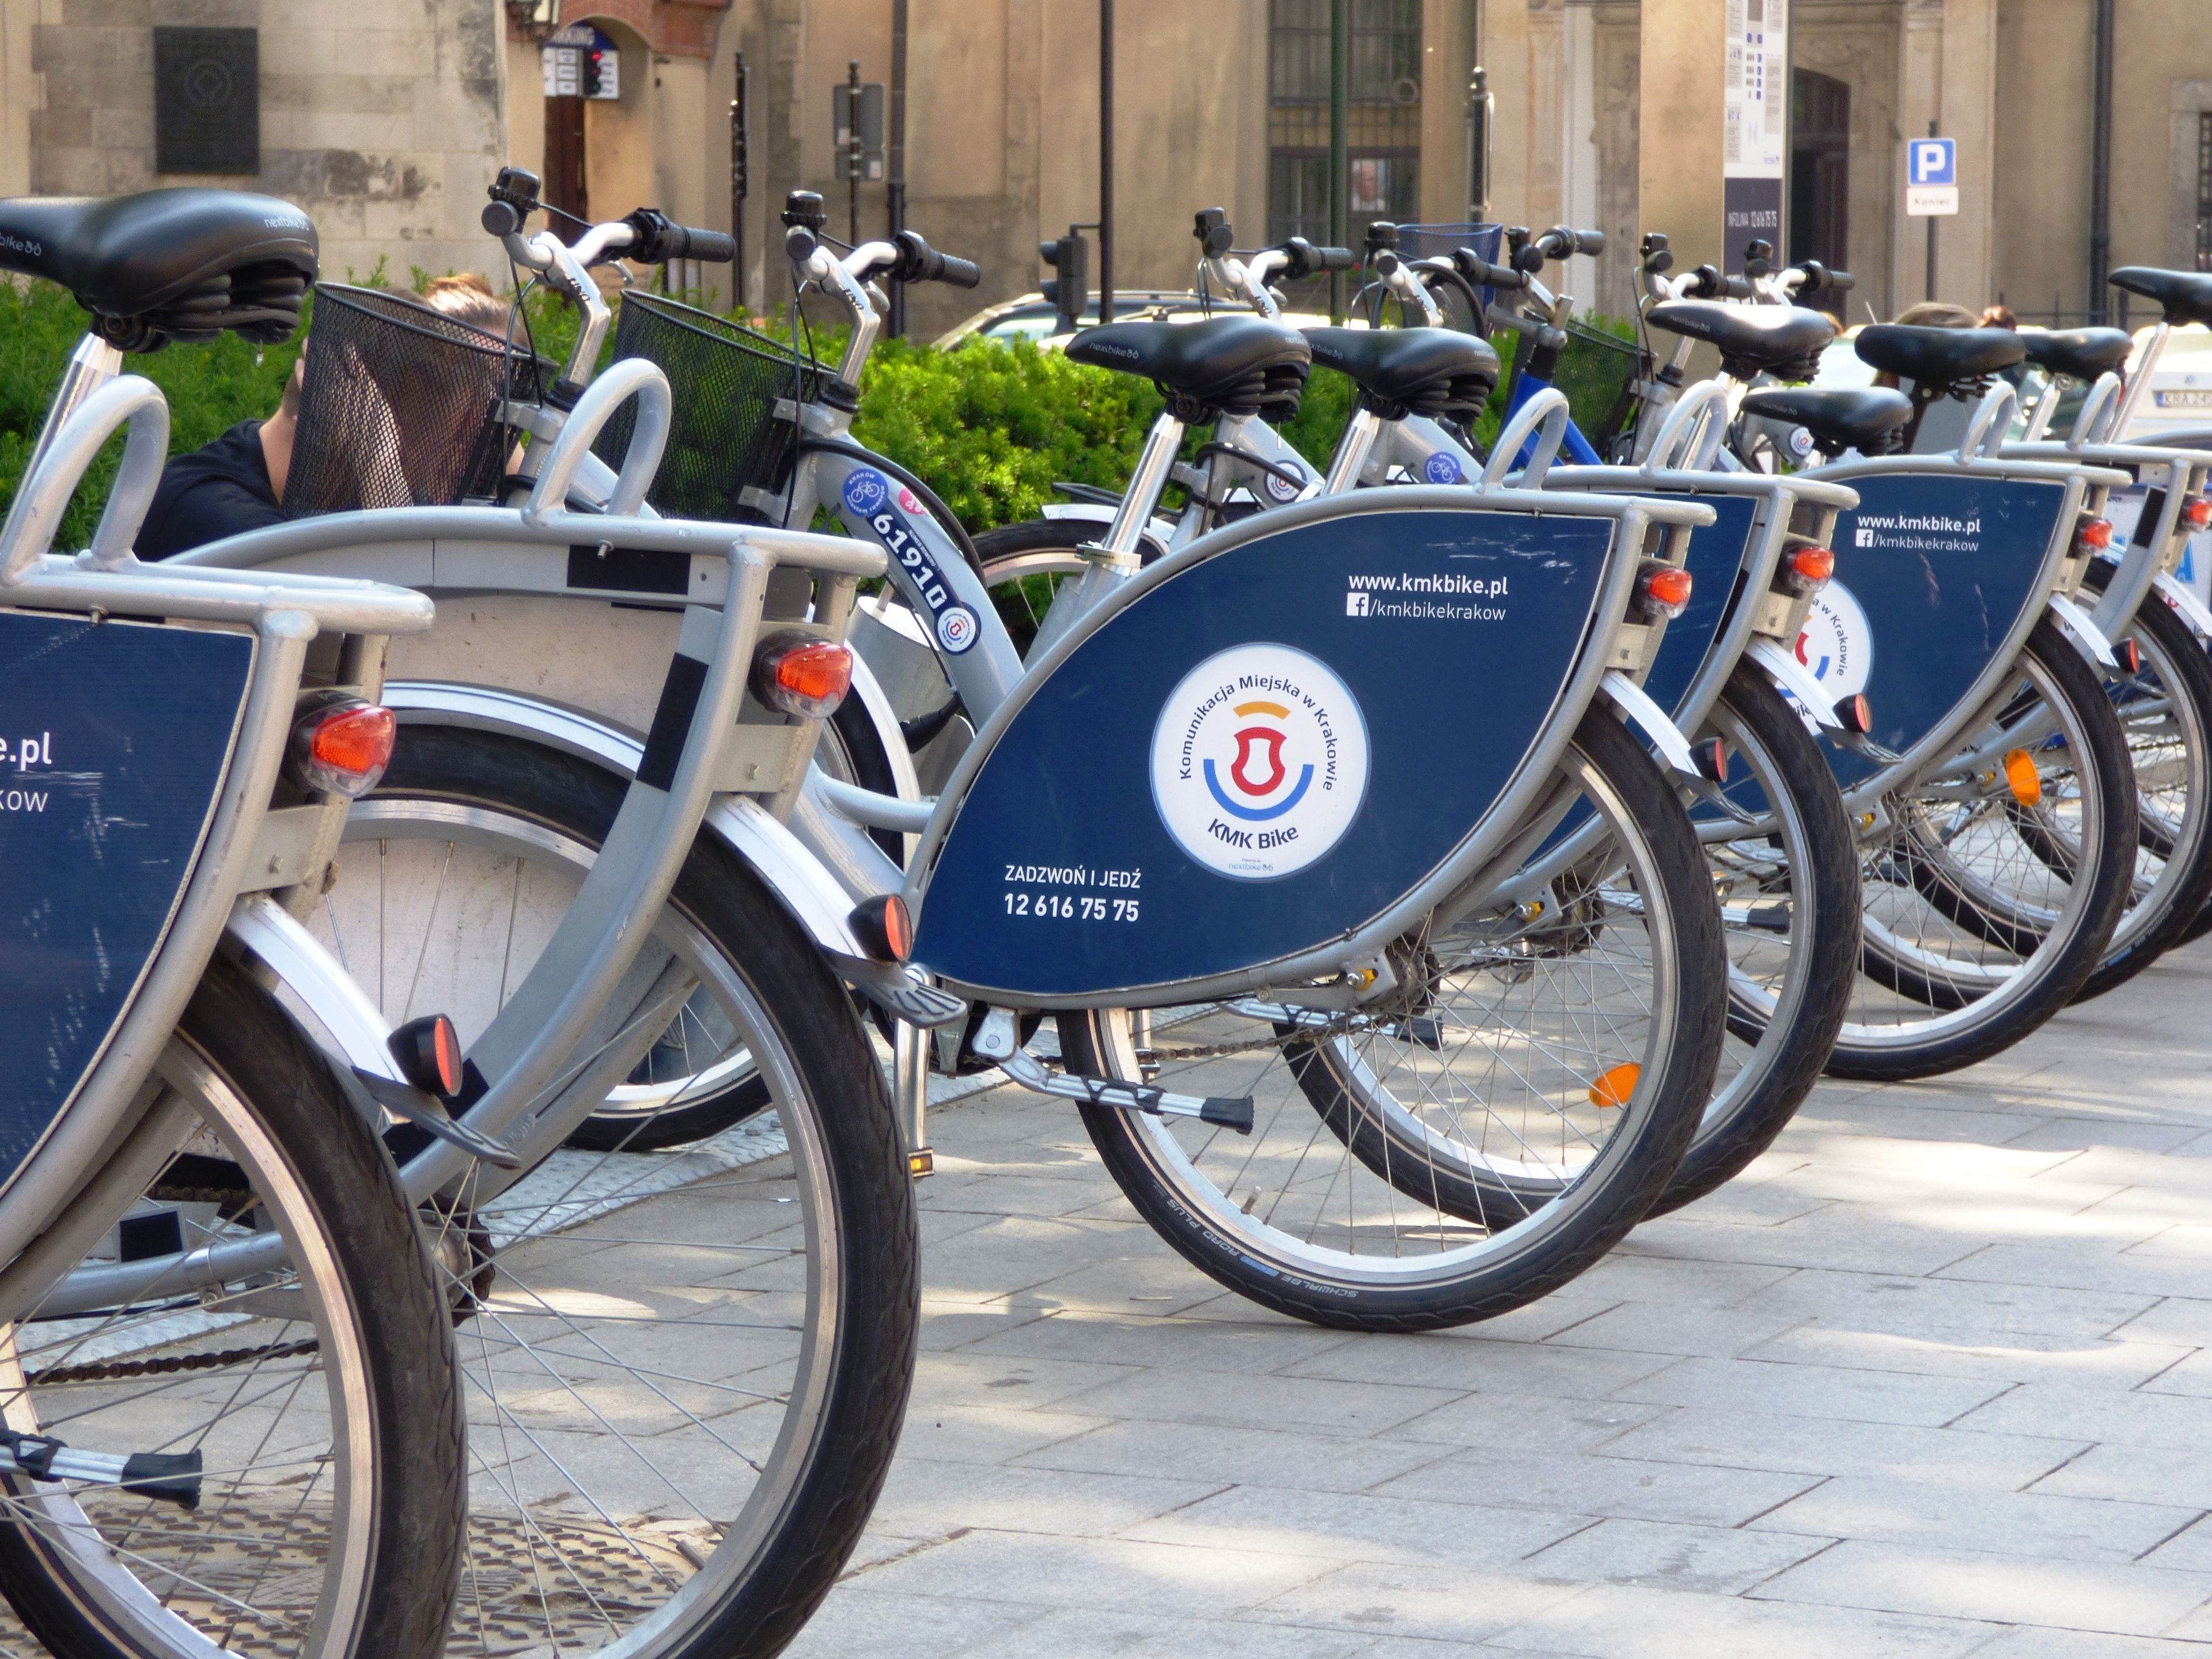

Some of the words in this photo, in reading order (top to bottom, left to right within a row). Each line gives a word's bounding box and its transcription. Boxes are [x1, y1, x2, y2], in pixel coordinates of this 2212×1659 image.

[1918, 144, 1945, 181] P
[1858, 515, 1980, 535] www.kmkbike.pl
[873, 513, 947, 609] 61910
[1349, 573, 1508, 599] www.kmkbike.pl
[1830, 615, 1848, 676] Krakowie
[1180, 684, 1236, 780] Komunikacja
[1239, 675, 1300, 698] Miejska
[1303, 694, 1316, 709] w
[1314, 709, 1338, 791] Krakowie
[1208, 818, 1253, 850] KMK
[1259, 827, 1299, 850] Bike
[1005, 865, 1086, 885] ZADZWOŃ
[1090, 870, 1095, 886] I
[1099, 868, 1142, 888] JEDŹ
[1229, 863, 1261, 871] nextbike
[1005, 893, 1029, 915] 12
[1035, 895, 1074, 918] 616
[1081, 897, 1107, 920] 75
[1113, 899, 1139, 922] 75
[1166, 1198, 1200, 1229] PLUS
[1281, 1274, 1359, 1298] SCHWALBE
